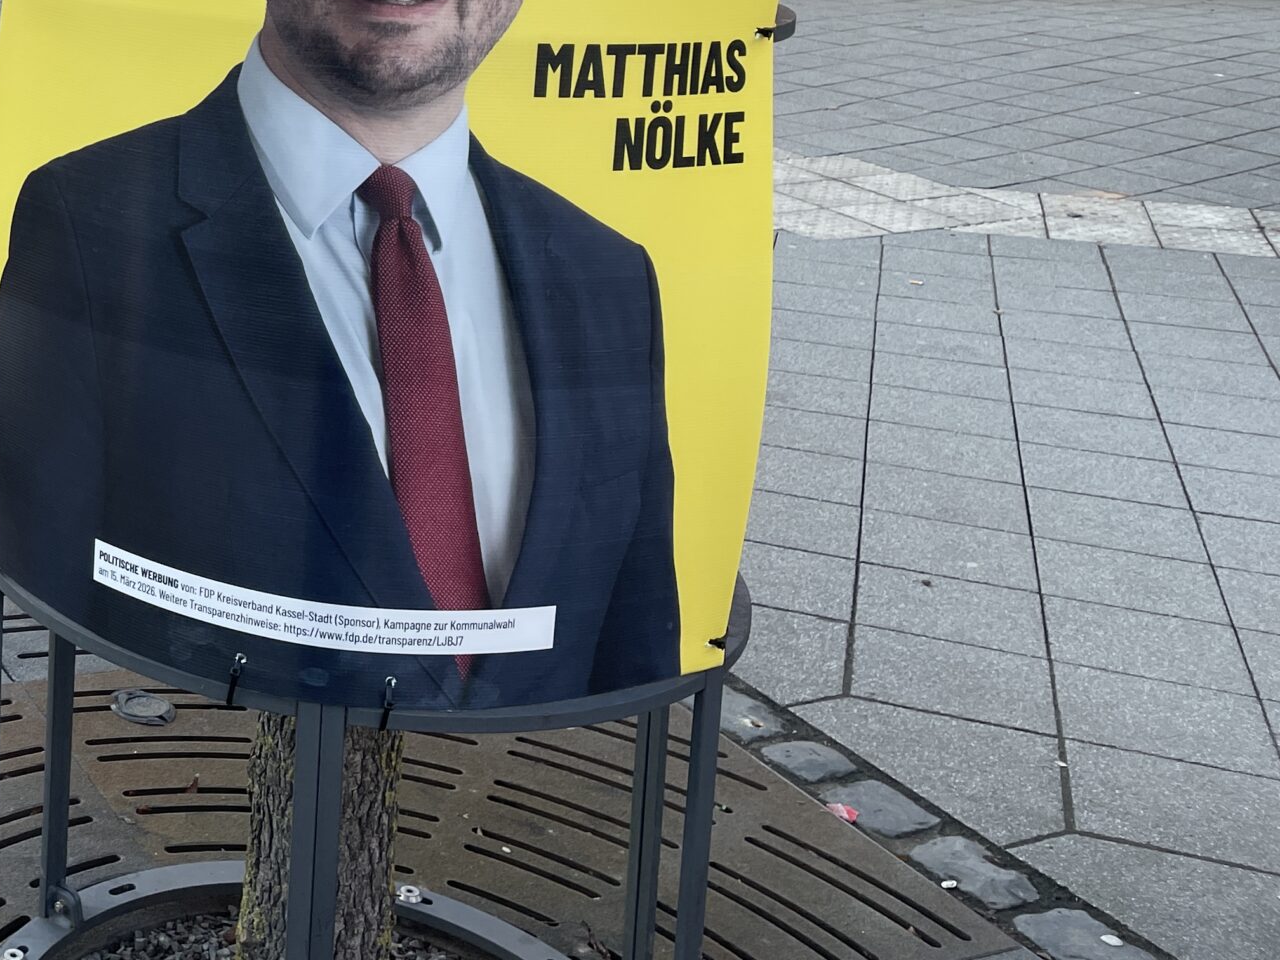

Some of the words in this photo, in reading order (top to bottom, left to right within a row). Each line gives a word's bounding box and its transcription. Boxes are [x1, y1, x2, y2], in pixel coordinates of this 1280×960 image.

[533, 39, 747, 99] MATTHIAS
[612, 99, 745, 172] NÖLKE
[98, 566, 109, 578] am
[110, 569, 119, 582] 15.
[120, 573, 136, 590] März
[137, 581, 157, 598] 2026.
[158, 589, 188, 608] Weitere
[189, 599, 281, 632] Transparenzhinweise:
[99, 549, 139, 575] POLITISCHE
[140, 566, 179, 589] WERBUNG
[180, 582, 198, 595] von:
[199, 586, 215, 599] FDP
[216, 590, 274, 615] Kreisverband
[275, 605, 333, 625] Kassel-Stadt
[383, 618, 432, 633] Kampagne
[433, 621, 448, 631] zur
[450, 618, 516, 631] Kommunalwahl
